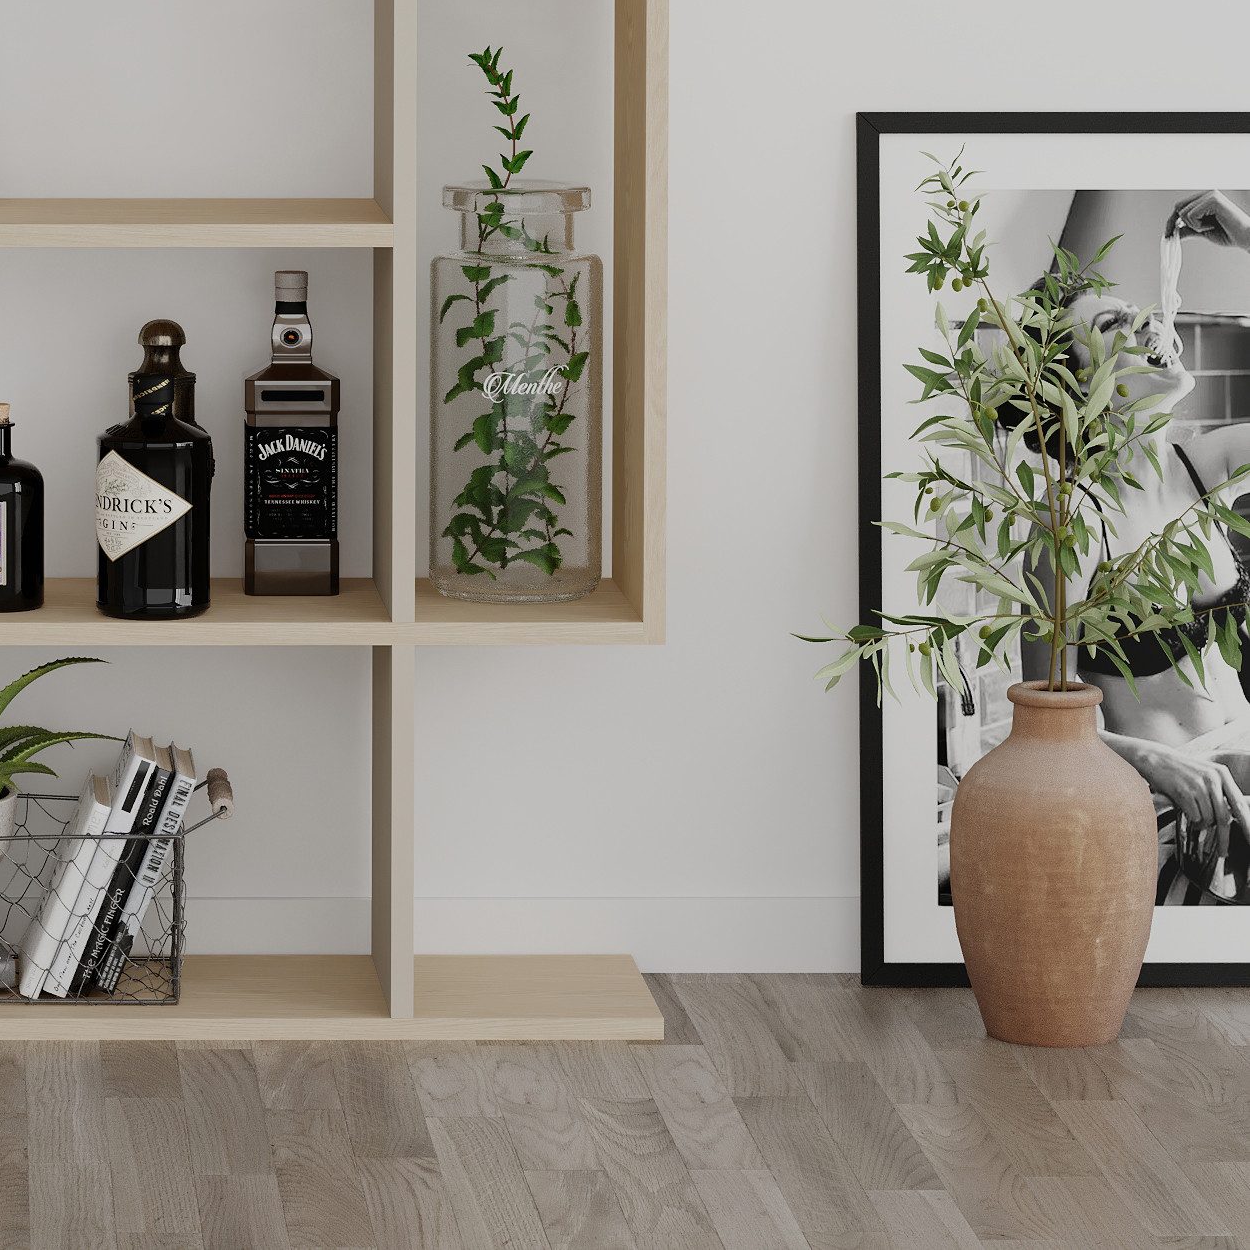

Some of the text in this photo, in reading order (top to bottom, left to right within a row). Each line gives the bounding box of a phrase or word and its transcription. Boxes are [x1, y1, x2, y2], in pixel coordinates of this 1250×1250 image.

[481, 364, 569, 403] Menthe
[258, 434, 327, 461] JACK DANIEL'S
[96, 495, 172, 514] NDRICK'S
[102, 518, 128, 530] GIN
[142, 775, 168, 826] Roald Dahl
[171, 779, 192, 807] FINAL
[91, 924, 110, 959] MAGIC
